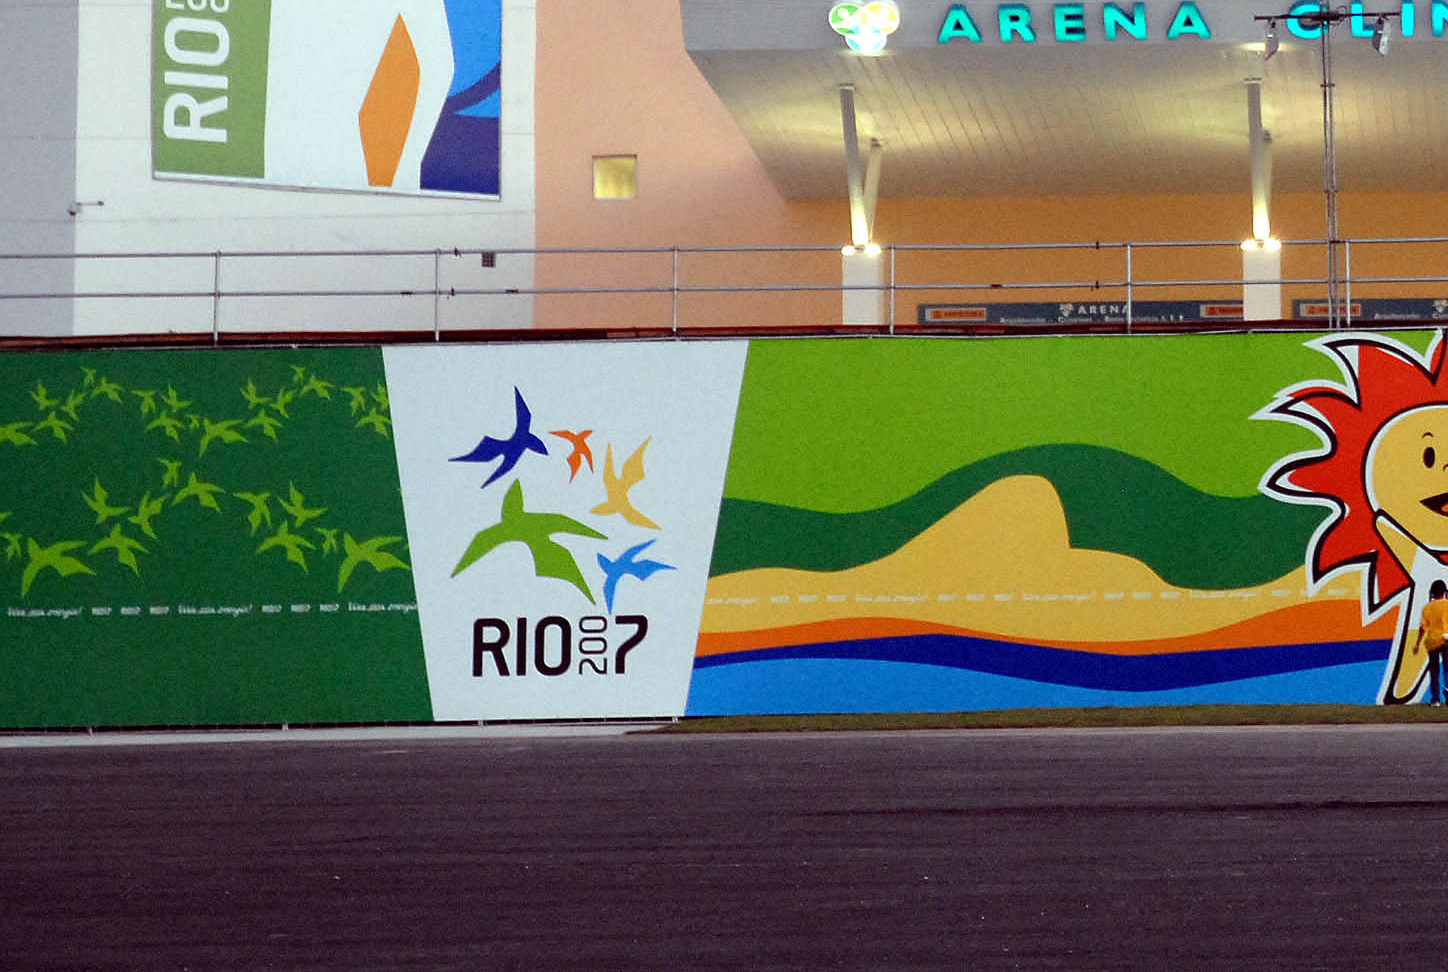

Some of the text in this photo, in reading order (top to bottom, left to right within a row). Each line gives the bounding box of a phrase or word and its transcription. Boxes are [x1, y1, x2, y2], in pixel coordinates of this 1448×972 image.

[936, 0, 1211, 43] ARENA
[163, 16, 230, 143] RIO
[472, 615, 572, 677] RIO
